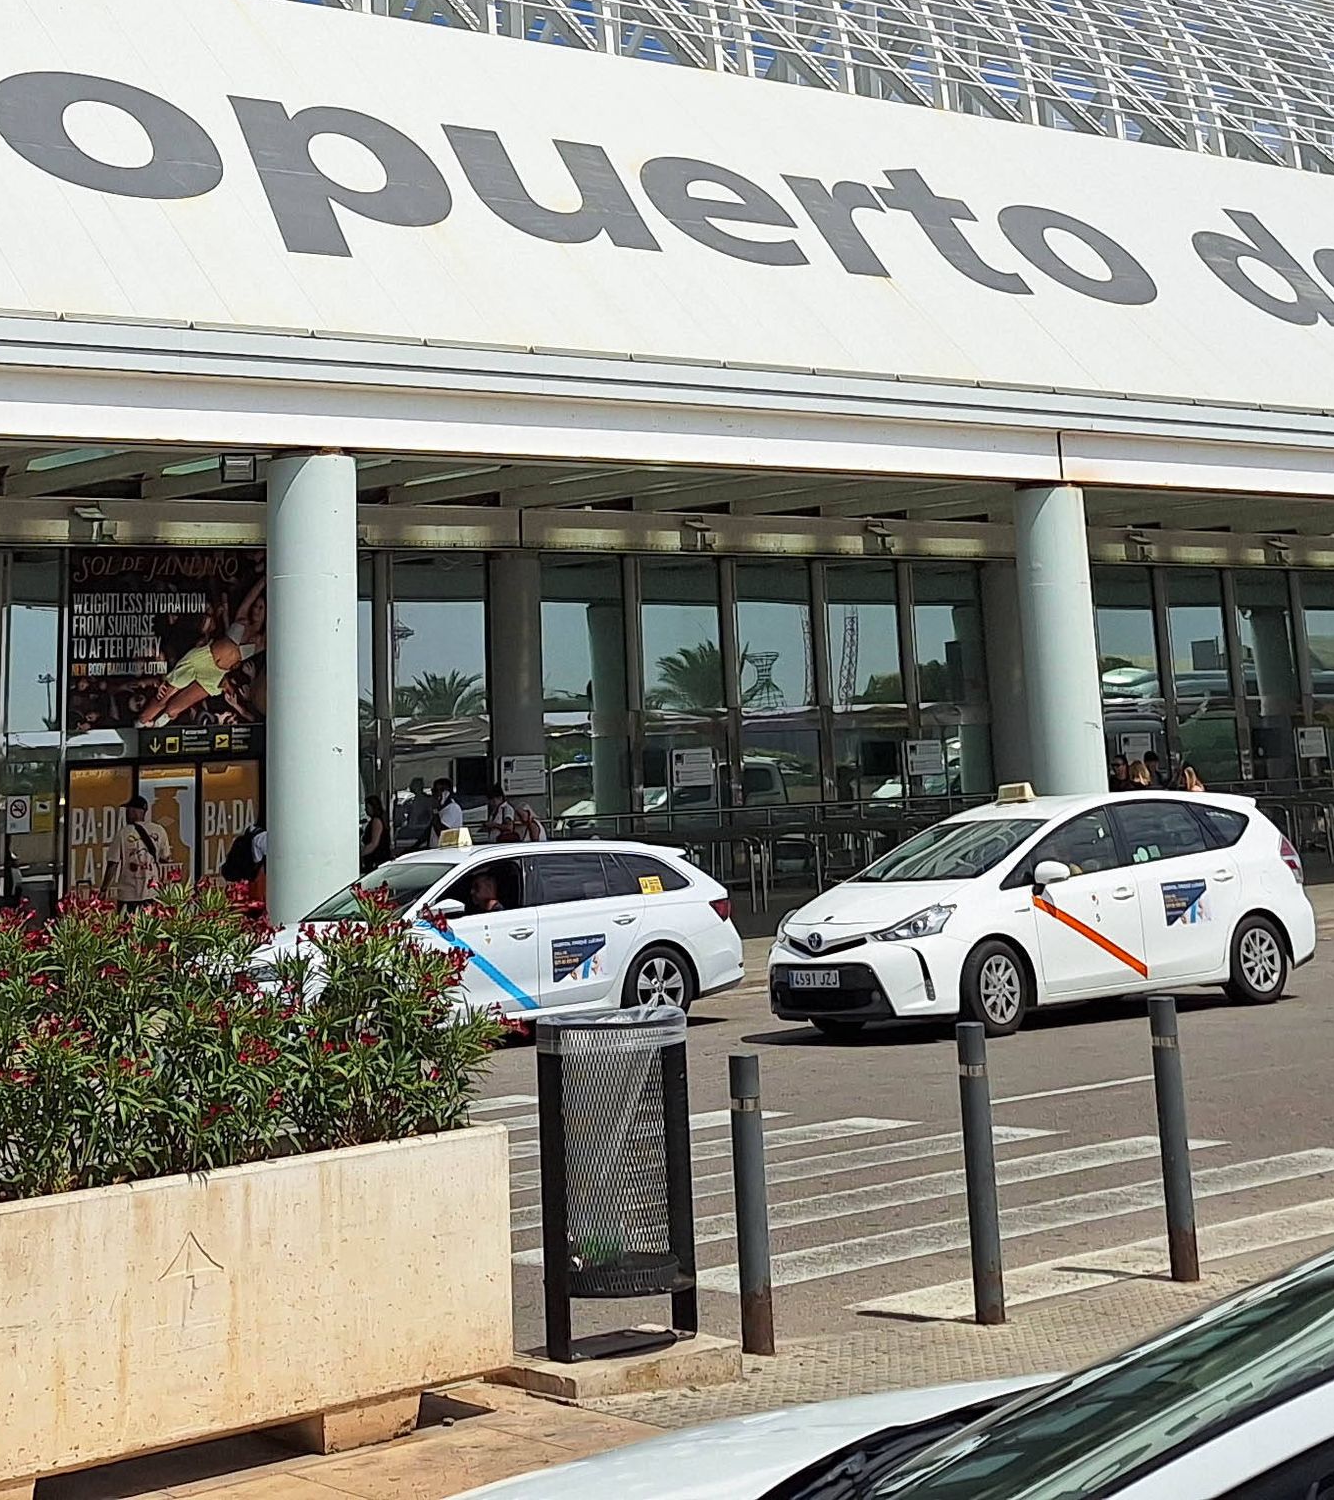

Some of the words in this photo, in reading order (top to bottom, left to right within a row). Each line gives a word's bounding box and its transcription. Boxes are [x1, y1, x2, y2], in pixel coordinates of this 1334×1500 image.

[73, 555, 118, 583] SOL
[119, 556, 145, 572] DE
[72, 592, 143, 614] WEIGHTLESS
[144, 592, 206, 614] HYDRATION
[72, 615, 105, 637] FROM
[107, 614, 156, 636] SUNRISE
[71, 637, 86, 659] TO
[88, 637, 124, 659] AFTER
[126, 636, 162, 659] PARTY
[820, 971, 838, 986] JZJ
